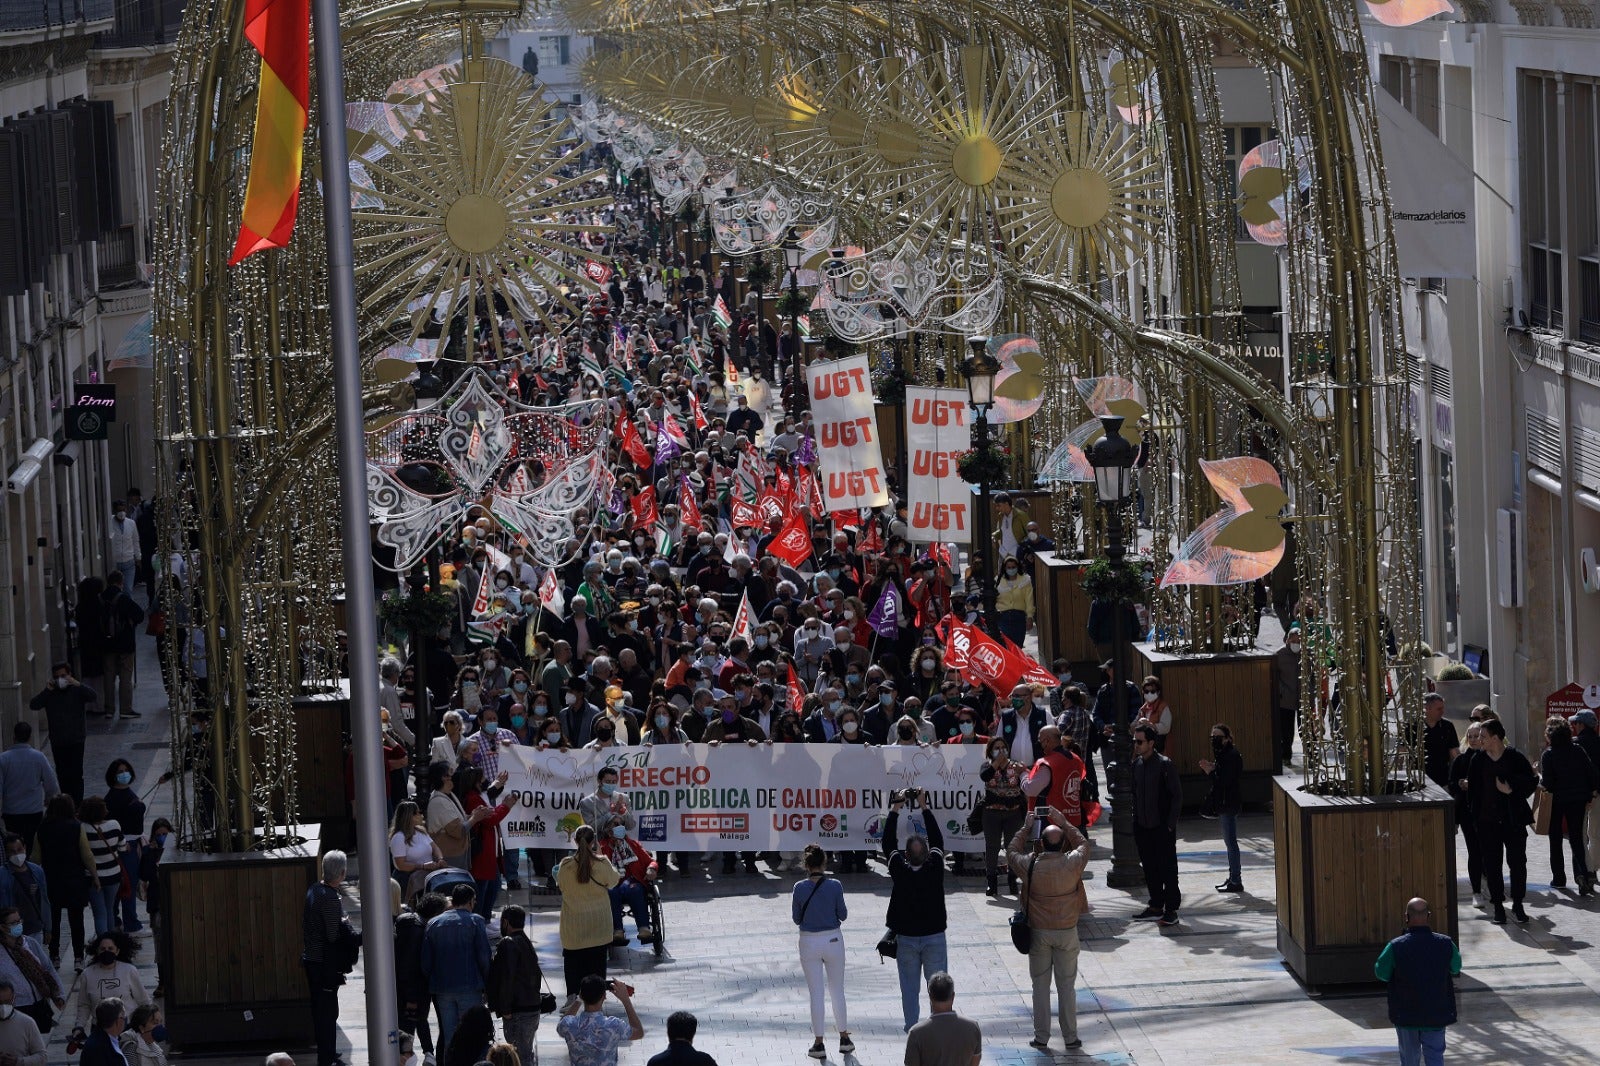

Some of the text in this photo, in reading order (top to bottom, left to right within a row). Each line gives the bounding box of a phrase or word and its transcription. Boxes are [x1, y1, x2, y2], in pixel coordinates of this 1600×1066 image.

[1263, 346, 1284, 358] LOL
[813, 367, 865, 400] UGT
[77, 395, 115, 407] Etam
[911, 398, 966, 427] UGT
[821, 416, 873, 449] UGT
[828, 467, 881, 499] UGT
[911, 501, 967, 531] UGT
[974, 645, 1003, 671] UGT
[632, 751, 651, 768] TU
[619, 765, 711, 788] ERECHO
[675, 782, 751, 809] PÚBLICA
[756, 788, 777, 809] DE
[782, 787, 857, 809] CALIDAD
[862, 788, 882, 809] EN
[684, 817, 733, 830] CCOO
[773, 813, 817, 832] UGT
